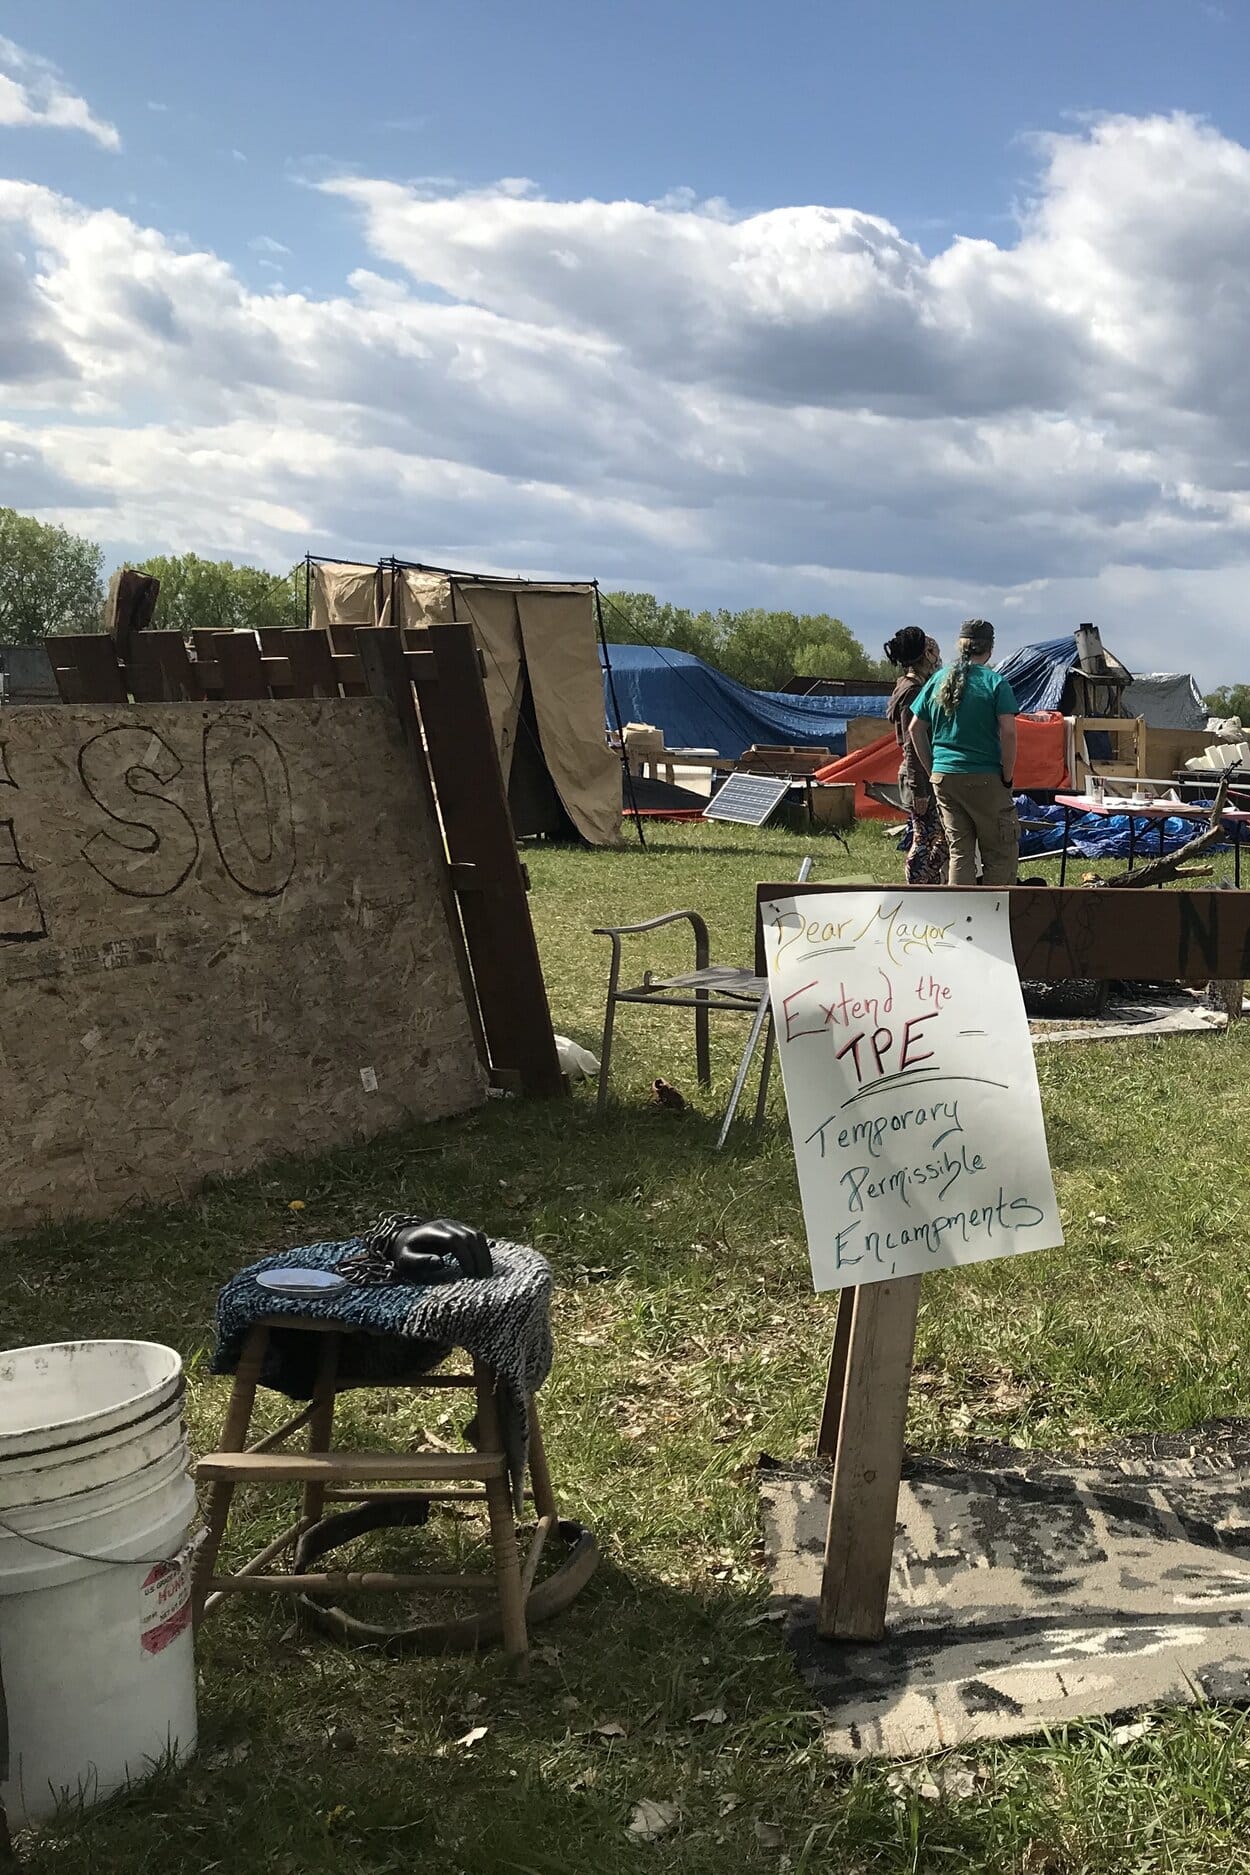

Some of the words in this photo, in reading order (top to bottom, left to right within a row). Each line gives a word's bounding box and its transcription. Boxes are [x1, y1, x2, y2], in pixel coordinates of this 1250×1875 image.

[773, 911, 856, 975] Dear
[783, 967, 894, 1043] Extend
[914, 975, 953, 1014] the
[835, 1011, 940, 1083] TPE
[805, 1099, 964, 1158] Temporary
[839, 1144, 987, 1213] Permissible
[834, 1186, 1045, 1270] Encampments
